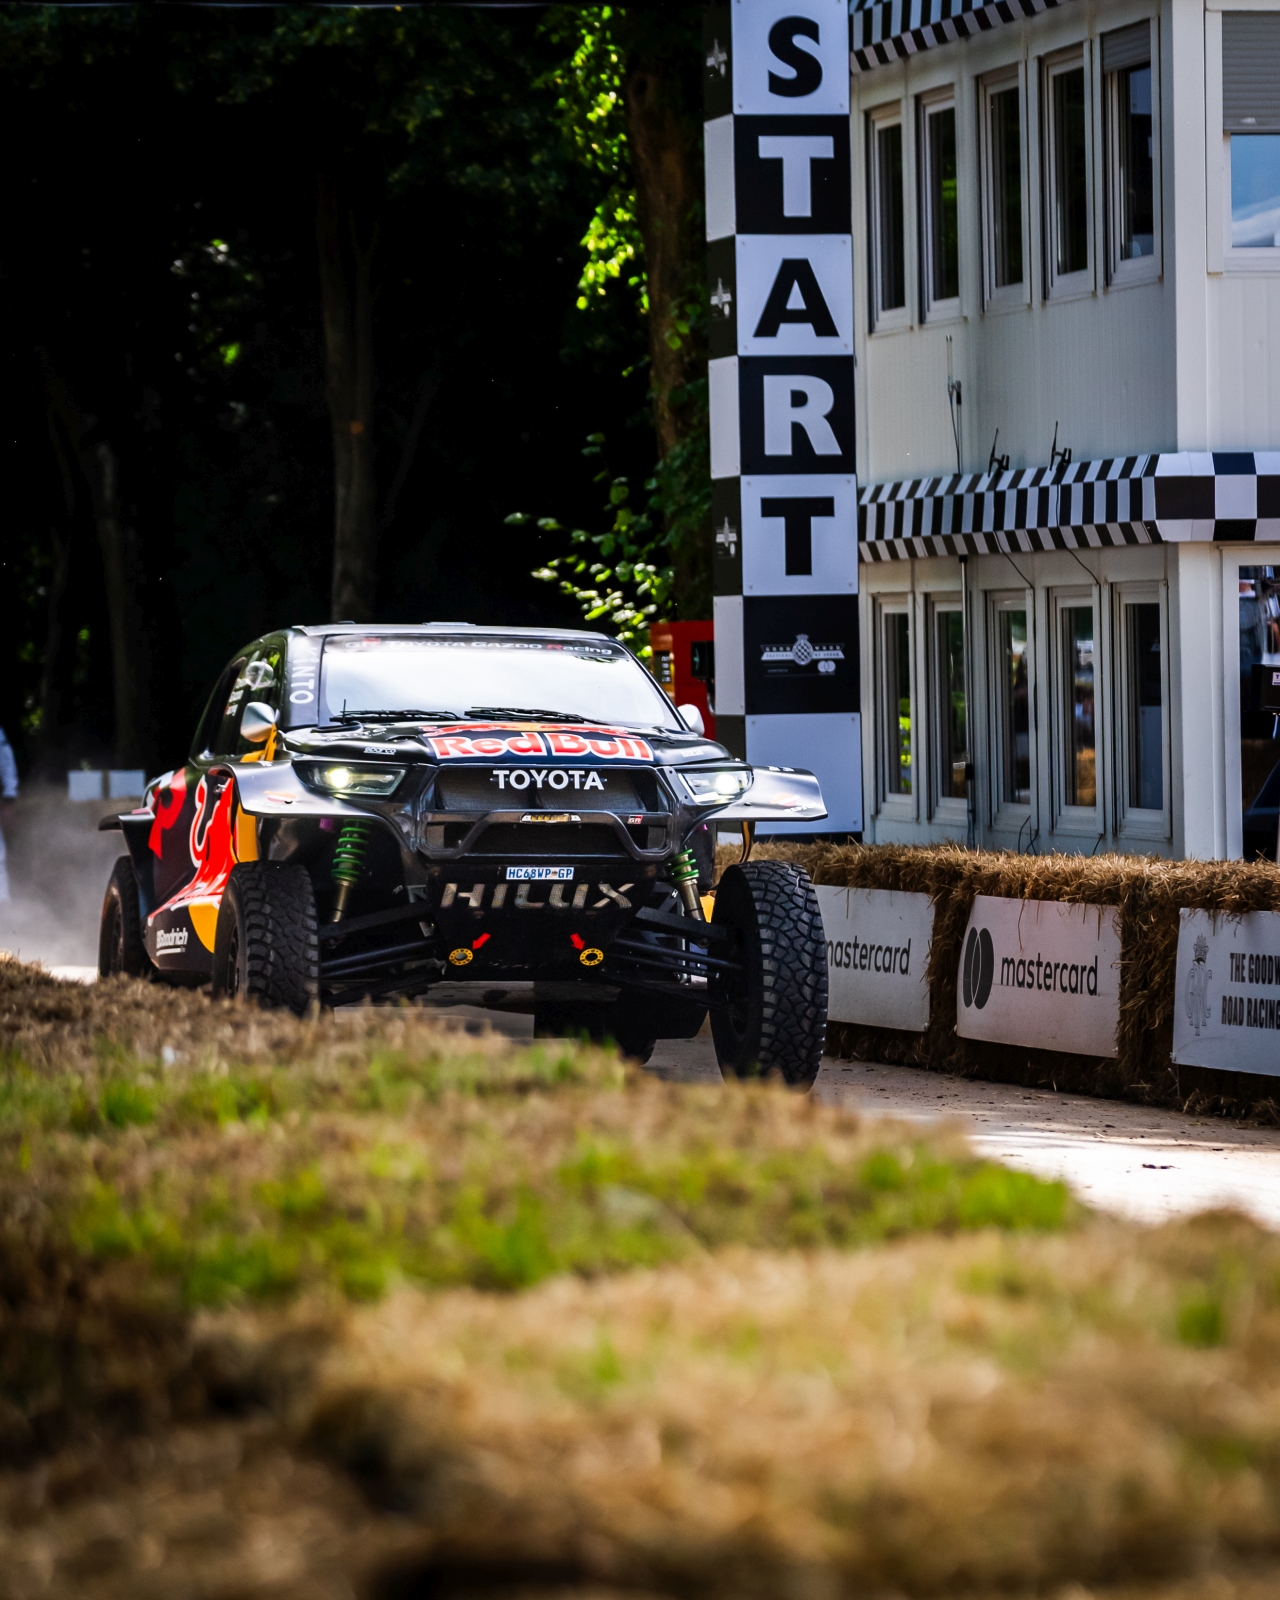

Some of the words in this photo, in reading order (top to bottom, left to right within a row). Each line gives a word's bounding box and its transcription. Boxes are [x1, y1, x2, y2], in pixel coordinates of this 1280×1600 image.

[752, 15, 842, 576] START
[385, 640, 466, 648] TOYOTA
[471, 641, 542, 649] GAZOO
[547, 643, 612, 655] Racing
[428, 732, 546, 760] Red
[546, 732, 654, 762] Bull
[493, 769, 605, 790] TOYOTA
[508, 868, 552, 879] HC68WP
[558, 868, 573, 879] GP
[440, 883, 635, 909] HILUX
[1001, 952, 1099, 997] mastercard
[1229, 952, 1246, 983] THE
[1221, 995, 1244, 1027] ROAD
